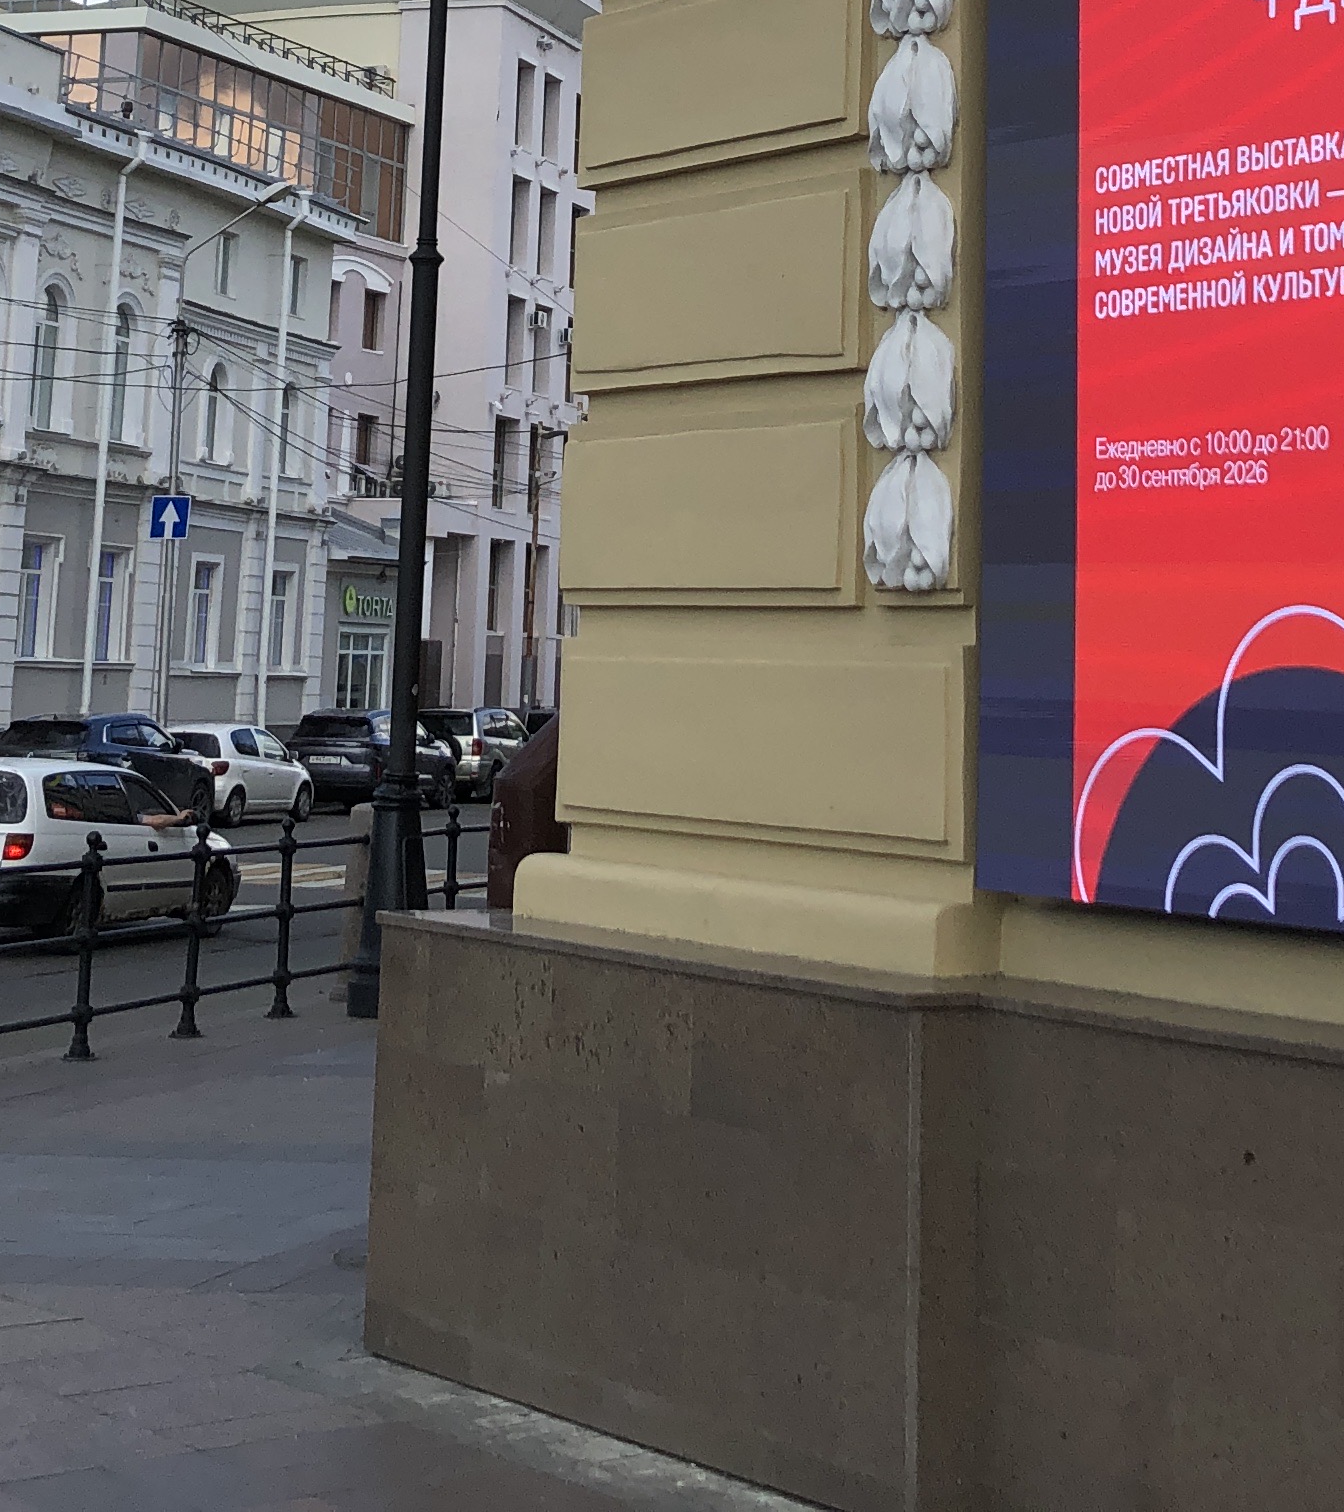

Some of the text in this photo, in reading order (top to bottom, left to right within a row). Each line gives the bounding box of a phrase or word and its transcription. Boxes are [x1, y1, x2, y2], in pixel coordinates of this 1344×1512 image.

[1094, 147, 1230, 194] СОВМЕСТНАЯ
[1095, 195, 1163, 235] НОВОЙ
[1168, 179, 1320, 226] ТРЕТЬЯКОВКИ
[1094, 242, 1163, 277] МУЗЕЯ
[1167, 226, 1272, 274] ДИЗАЙНА
[1278, 227, 1294, 256] И
[1094, 270, 1246, 320] СОВРЕМЕННОЙ
[1095, 425, 1330, 461] Ежедневно с 10:00 до 21:00
[1094, 459, 1268, 492] до 30 сентября 2026
[357, 595, 394, 618] TORTA
